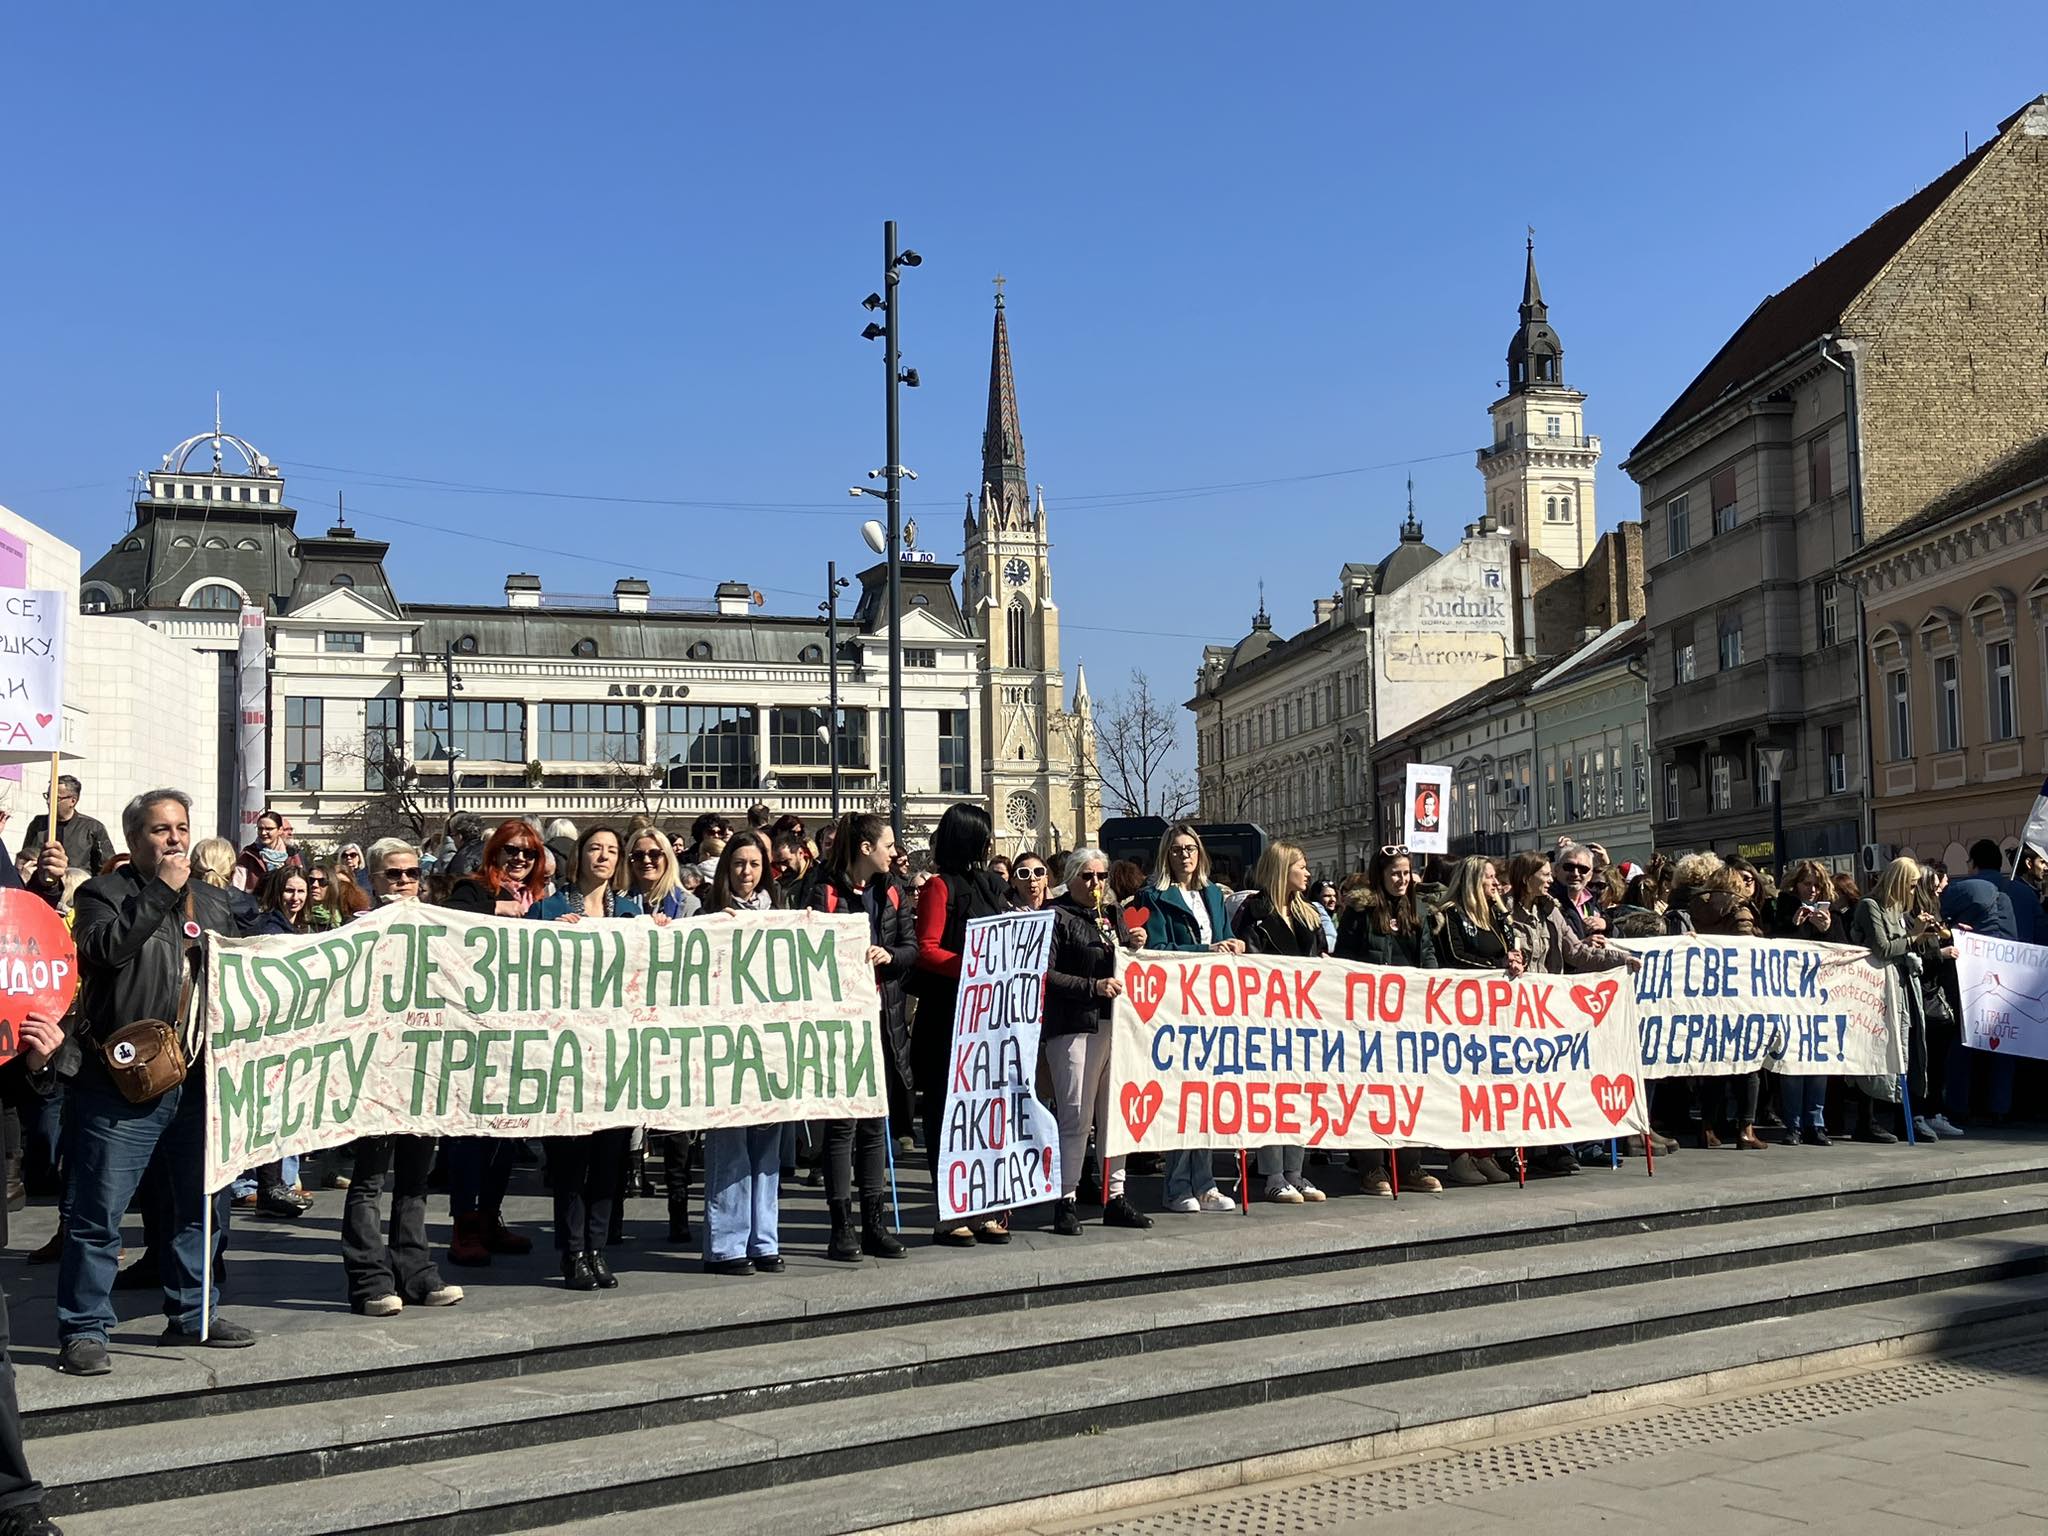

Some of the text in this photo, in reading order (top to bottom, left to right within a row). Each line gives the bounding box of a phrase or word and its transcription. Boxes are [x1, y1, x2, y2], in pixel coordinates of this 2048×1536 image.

[6, 597, 42, 623] СЕ,
[1418, 595, 1505, 618] Rudnik
[1408, 643, 1479, 665] Arrow
[608, 684, 690, 698] АПОЛО
[212, 931, 380, 1049] ДОБРО
[382, 924, 447, 1013] ЈЕ
[464, 927, 625, 1014] ЗНАТИ
[646, 928, 710, 1006] НА
[731, 928, 843, 1004] КОМ
[1133, 975, 1157, 1004] НС
[1683, 947, 1738, 997] СВЕ
[1750, 948, 1828, 1005] НОСИ,
[1178, 963, 1565, 1028] КОРАК ПО КОРАК
[1828, 982, 1887, 1017] ПРОФЕСОРИ
[1151, 1024, 1590, 1075] СТУДЕНТИ И ПРОФЕСОРИ
[1665, 1013, 1791, 1064] СРАМОТУ
[218, 1033, 379, 1163] МЕСТУ
[401, 1029, 583, 1116] ТРЕБА
[604, 1020, 877, 1113] ИСТРАЈАТИ
[1600, 1086, 1627, 1110] НИ
[1128, 1095, 1153, 1125] КГ
[1177, 1080, 1572, 1146] ПОБЕЂУЈУ МРАК
